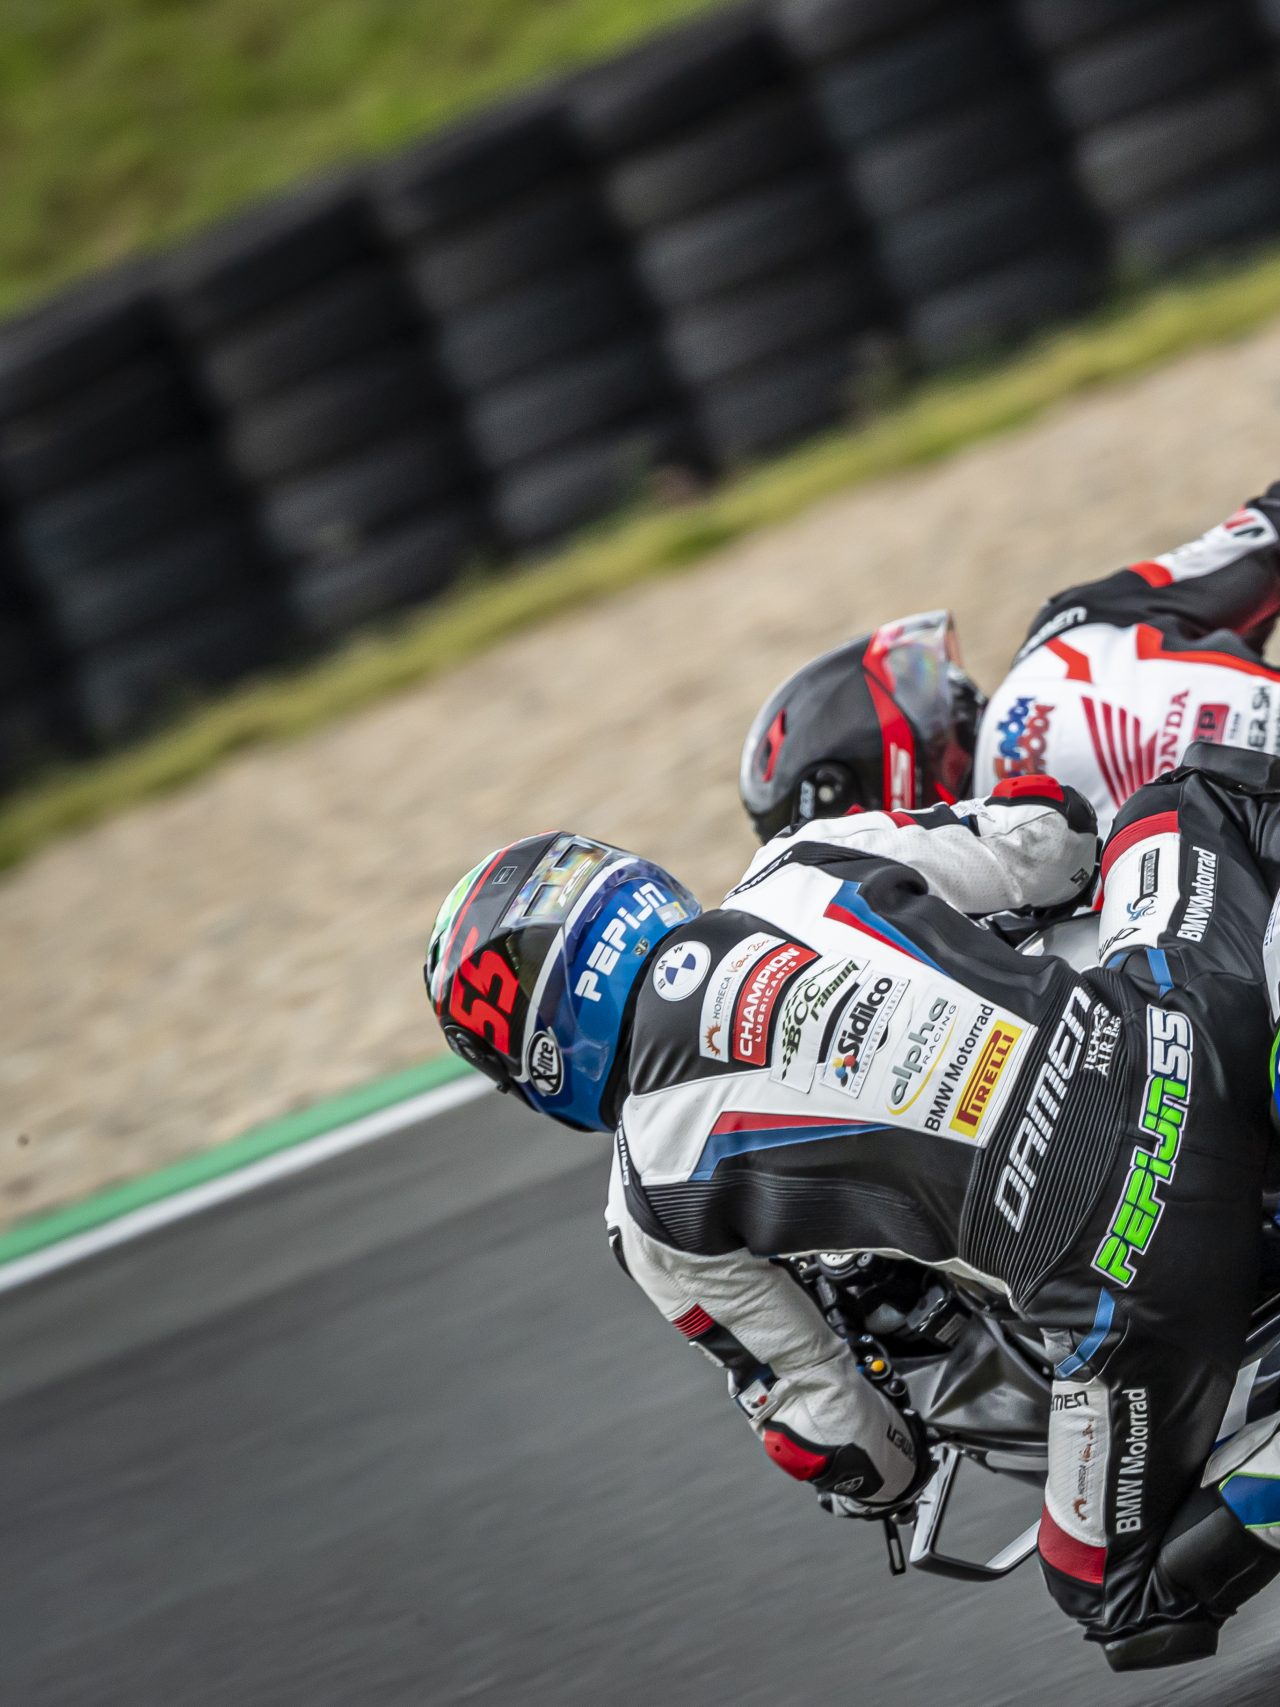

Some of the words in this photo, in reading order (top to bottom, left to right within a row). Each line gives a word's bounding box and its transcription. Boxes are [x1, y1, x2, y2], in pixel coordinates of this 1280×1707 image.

[1160, 689, 1190, 777] ONDA
[714, 976, 731, 1019] HORECA
[739, 946, 801, 1057] CHAMPION
[755, 960, 797, 1043] LUBRICANTS
[837, 977, 893, 1057] Sidilco
[923, 1004, 957, 1065] RACING
[892, 997, 949, 1105] alpha
[924, 1081, 955, 1132] BMW
[949, 1003, 995, 1083] Motorrad
[956, 1029, 1015, 1127] PIRELLI
[1051, 1390, 1089, 1412] MEN
[1120, 1386, 1148, 1477] Motorrad
[1116, 1478, 1145, 1535] BMW
